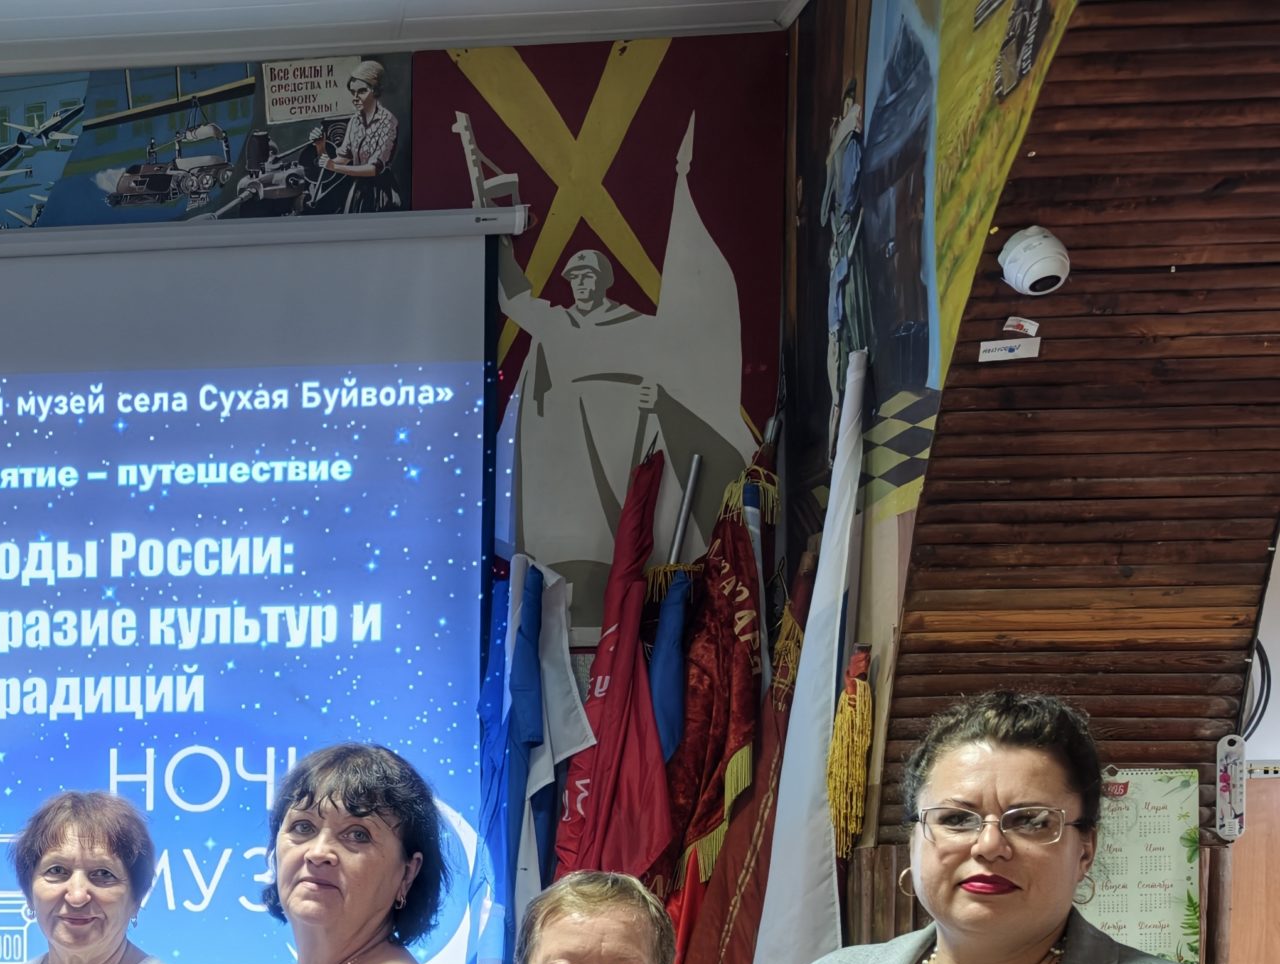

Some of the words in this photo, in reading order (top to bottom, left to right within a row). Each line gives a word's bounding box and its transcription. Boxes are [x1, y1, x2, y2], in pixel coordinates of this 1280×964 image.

[270, 80, 321, 94] СРЕДСТВА
[325, 78, 339, 89] НА
[271, 94, 319, 107] ОБОРОНУ
[17, 382, 105, 422] музей
[117, 390, 188, 414] села
[198, 384, 289, 418] Сухая
[302, 376, 454, 416] Буйвола»
[117, 458, 352, 492] путешествие
[110, 532, 295, 578] России:
[149, 603, 338, 651] культур
[352, 603, 382, 641] и
